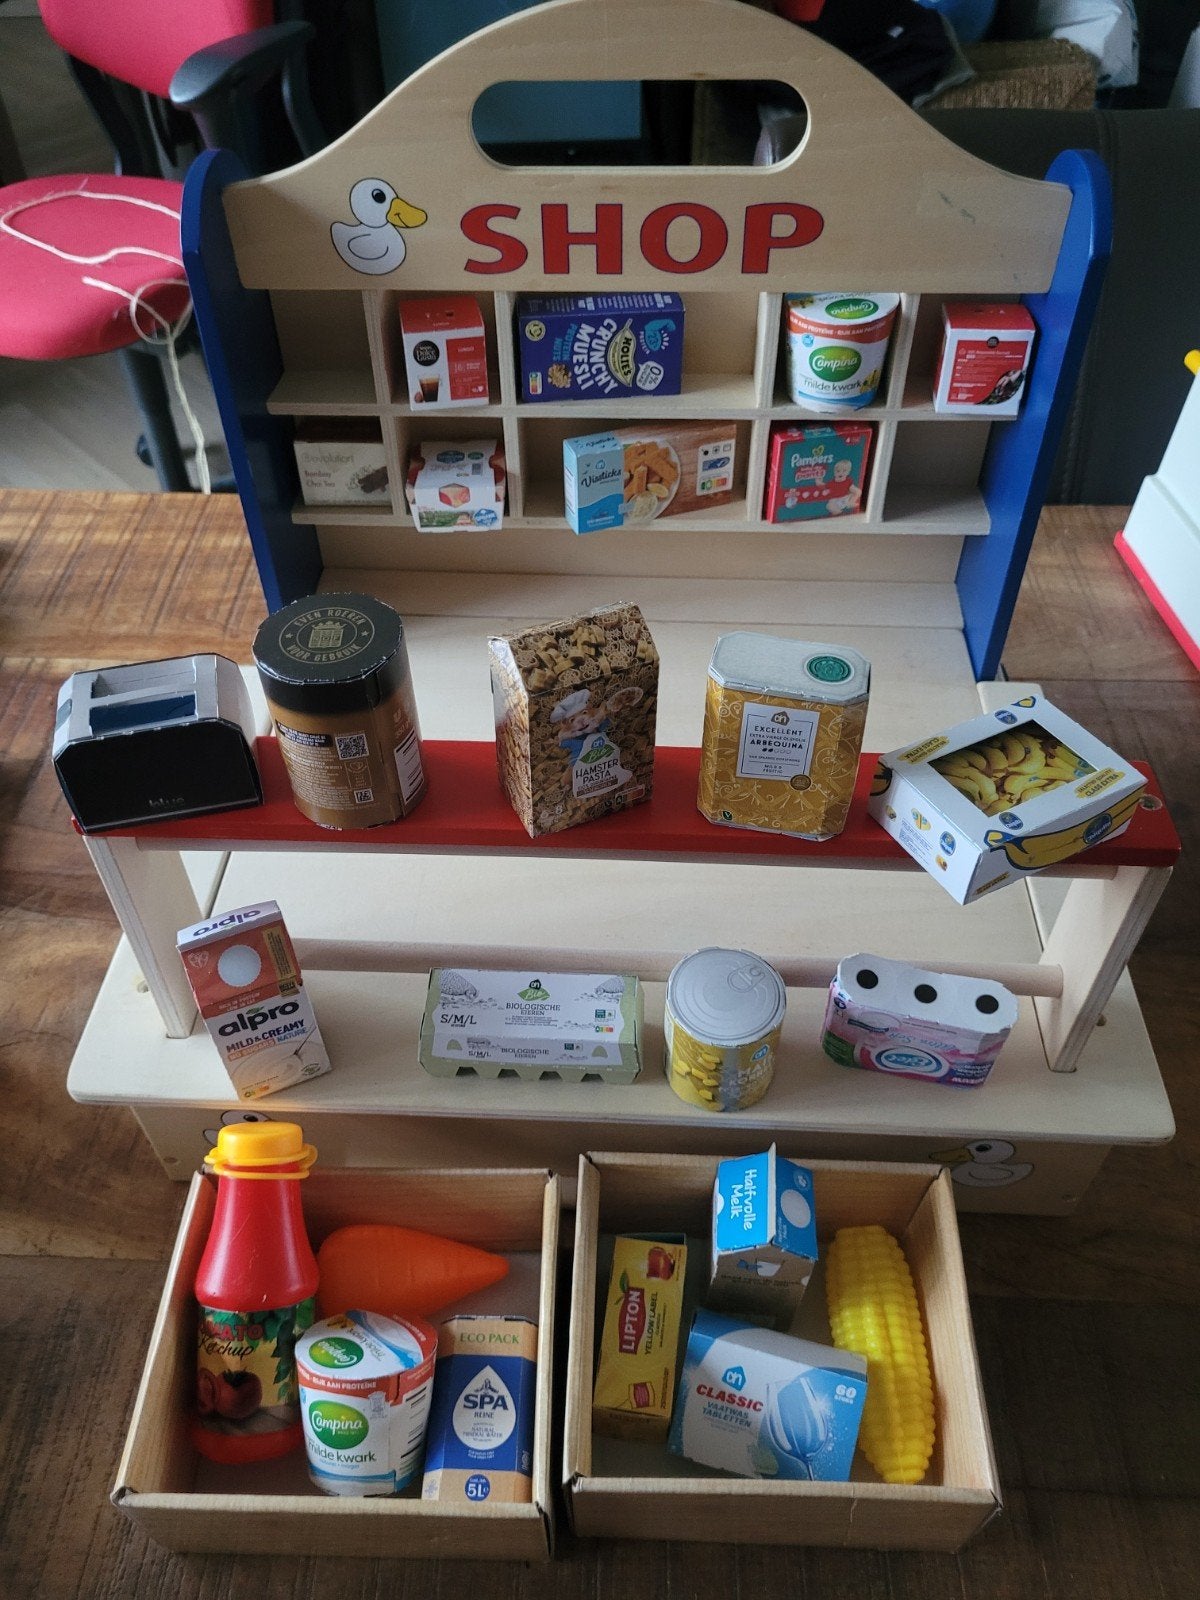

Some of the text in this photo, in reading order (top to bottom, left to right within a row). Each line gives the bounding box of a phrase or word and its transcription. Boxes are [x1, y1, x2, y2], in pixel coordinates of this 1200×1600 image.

[460, 202, 825, 275] SHOP
[572, 323, 596, 391] MUESLI
[590, 318, 618, 394] CRUNCHY
[812, 355, 858, 372] Campina
[804, 378, 862, 392] milde kwark
[791, 453, 834, 468] Pampers
[581, 469, 622, 488] Vissticks
[294, 609, 366, 627] EVEN ROEREN
[287, 643, 361, 662] VOOR GEBRUIK
[754, 725, 803, 736] EXCELLENT
[749, 739, 803, 750] ARBEQUINA
[575, 759, 619, 779] HAMSTER
[582, 771, 611, 785] PASTA
[1100, 774, 1120, 787] EXTRA
[193, 909, 261, 938] alpro
[505, 1002, 561, 1012] BIOLOGISCHE
[218, 1000, 299, 1037] alpro
[440, 1014, 477, 1026] S/M/L
[226, 1036, 253, 1053] MILD
[262, 1019, 305, 1040] CREAMY
[501, 1047, 550, 1055] BIOLOGISCHE
[730, 1184, 744, 1220] Melk
[743, 1168, 758, 1232] Halfvolle
[622, 1289, 641, 1351] LIPTON
[644, 1291, 658, 1355] YELLOW LABEL
[460, 1332, 520, 1344] ECO PACK
[199, 1335, 255, 1361] Ketchup
[326, 1380, 341, 1388] AAN
[341, 1381, 377, 1390] PROTEÏNE
[463, 1394, 509, 1411] SPA
[696, 1383, 764, 1412] CLASSIC
[702, 1408, 752, 1428] TABLETTEN
[707, 1401, 749, 1419] VAATWAS
[312, 1410, 363, 1436] Campina
[309, 1440, 376, 1463] milde kwark
